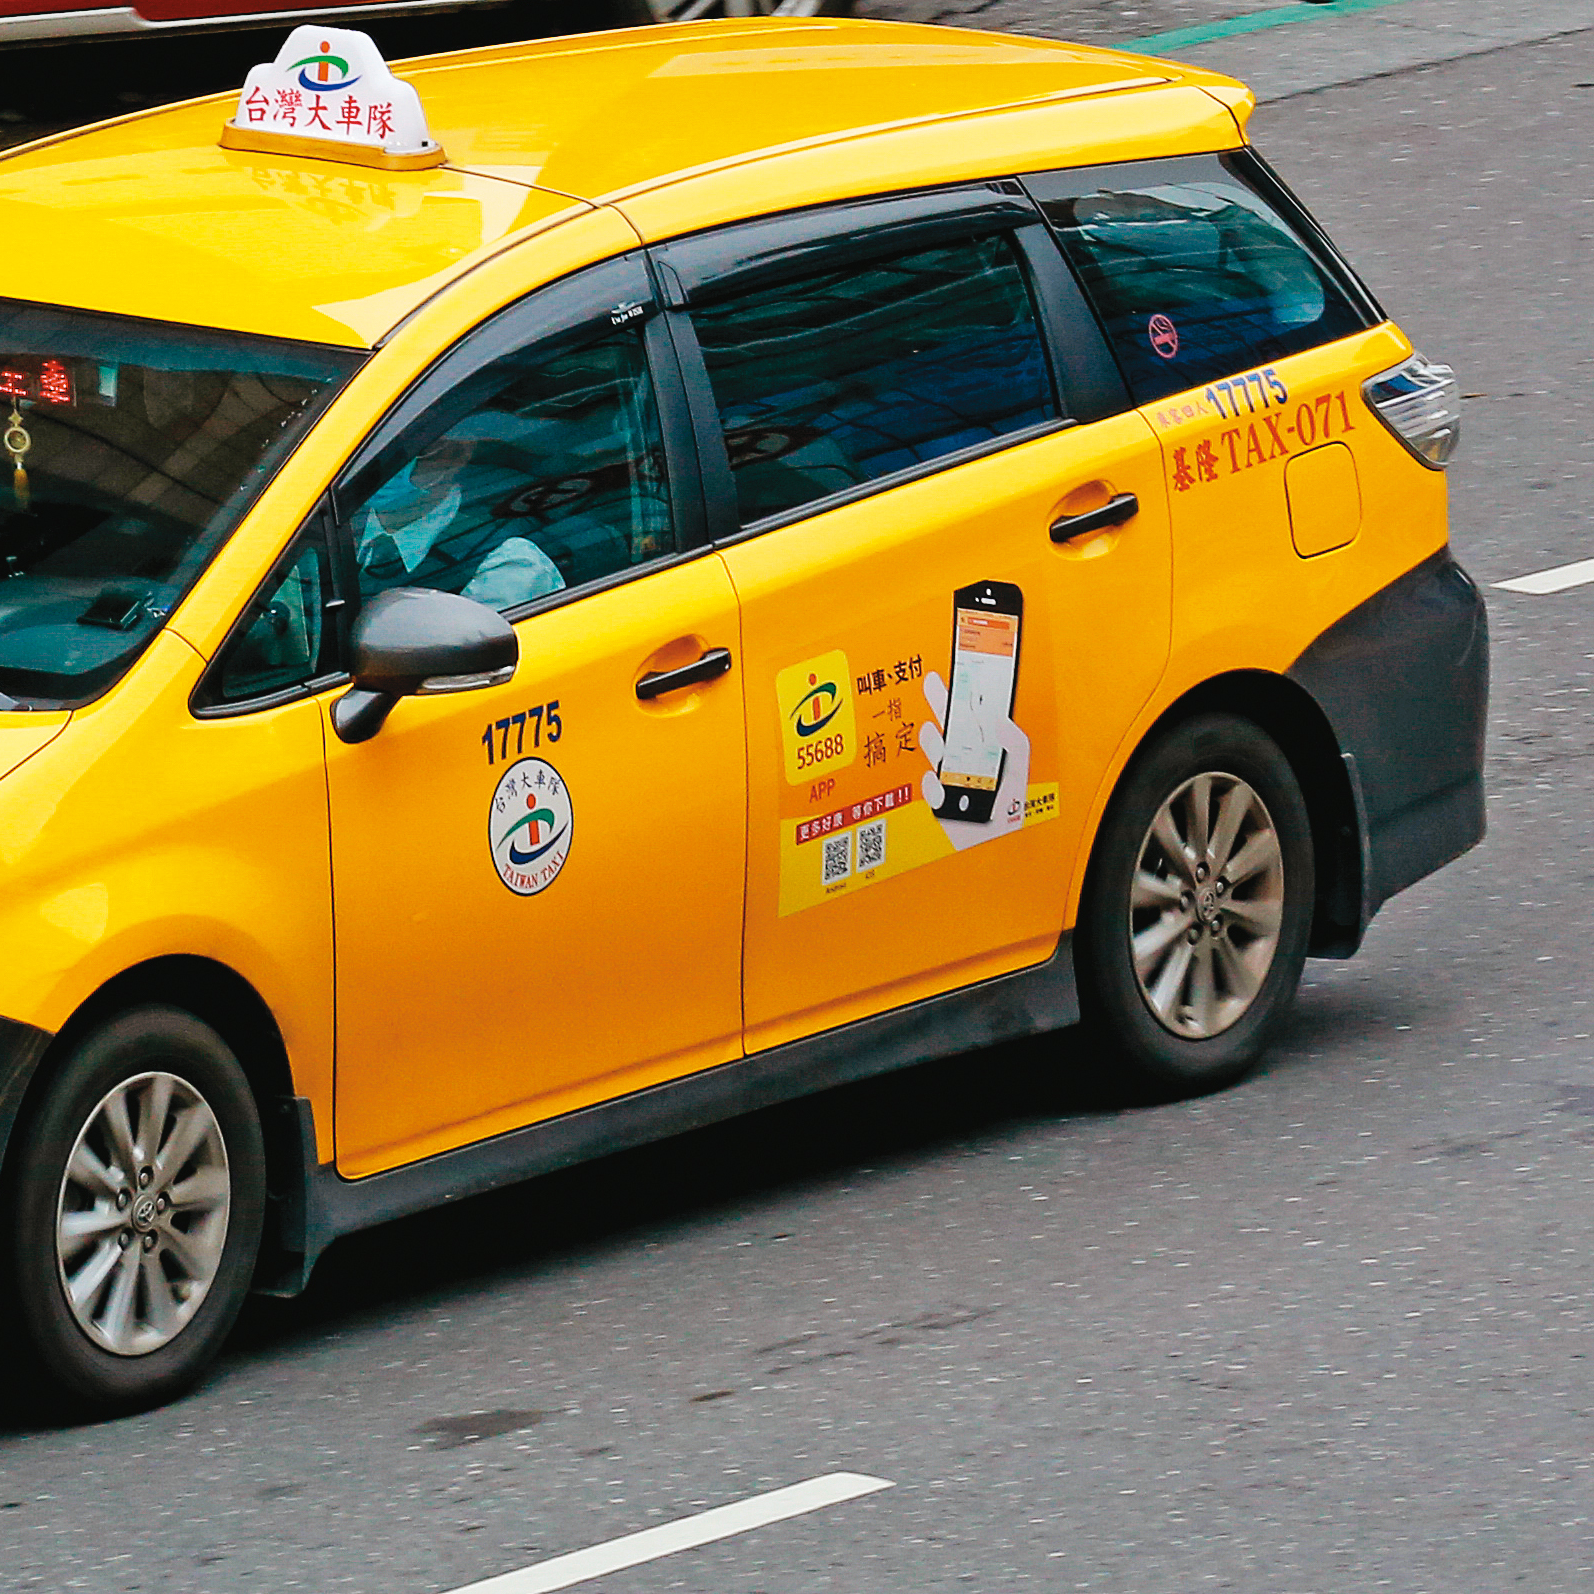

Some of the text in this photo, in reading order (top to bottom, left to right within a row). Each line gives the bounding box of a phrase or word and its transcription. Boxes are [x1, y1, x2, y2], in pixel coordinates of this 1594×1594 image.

[245, 86, 396, 140] 台灣大車隊
[1205, 368, 1288, 420] 17775
[1220, 390, 1356, 474] TAX-071
[481, 700, 562, 765] 17775
[797, 733, 844, 770] 55688
[495, 769, 562, 814] 台灣大車隊
[809, 778, 835, 804] APP
[502, 850, 565, 890] TAIWAN TAXI
